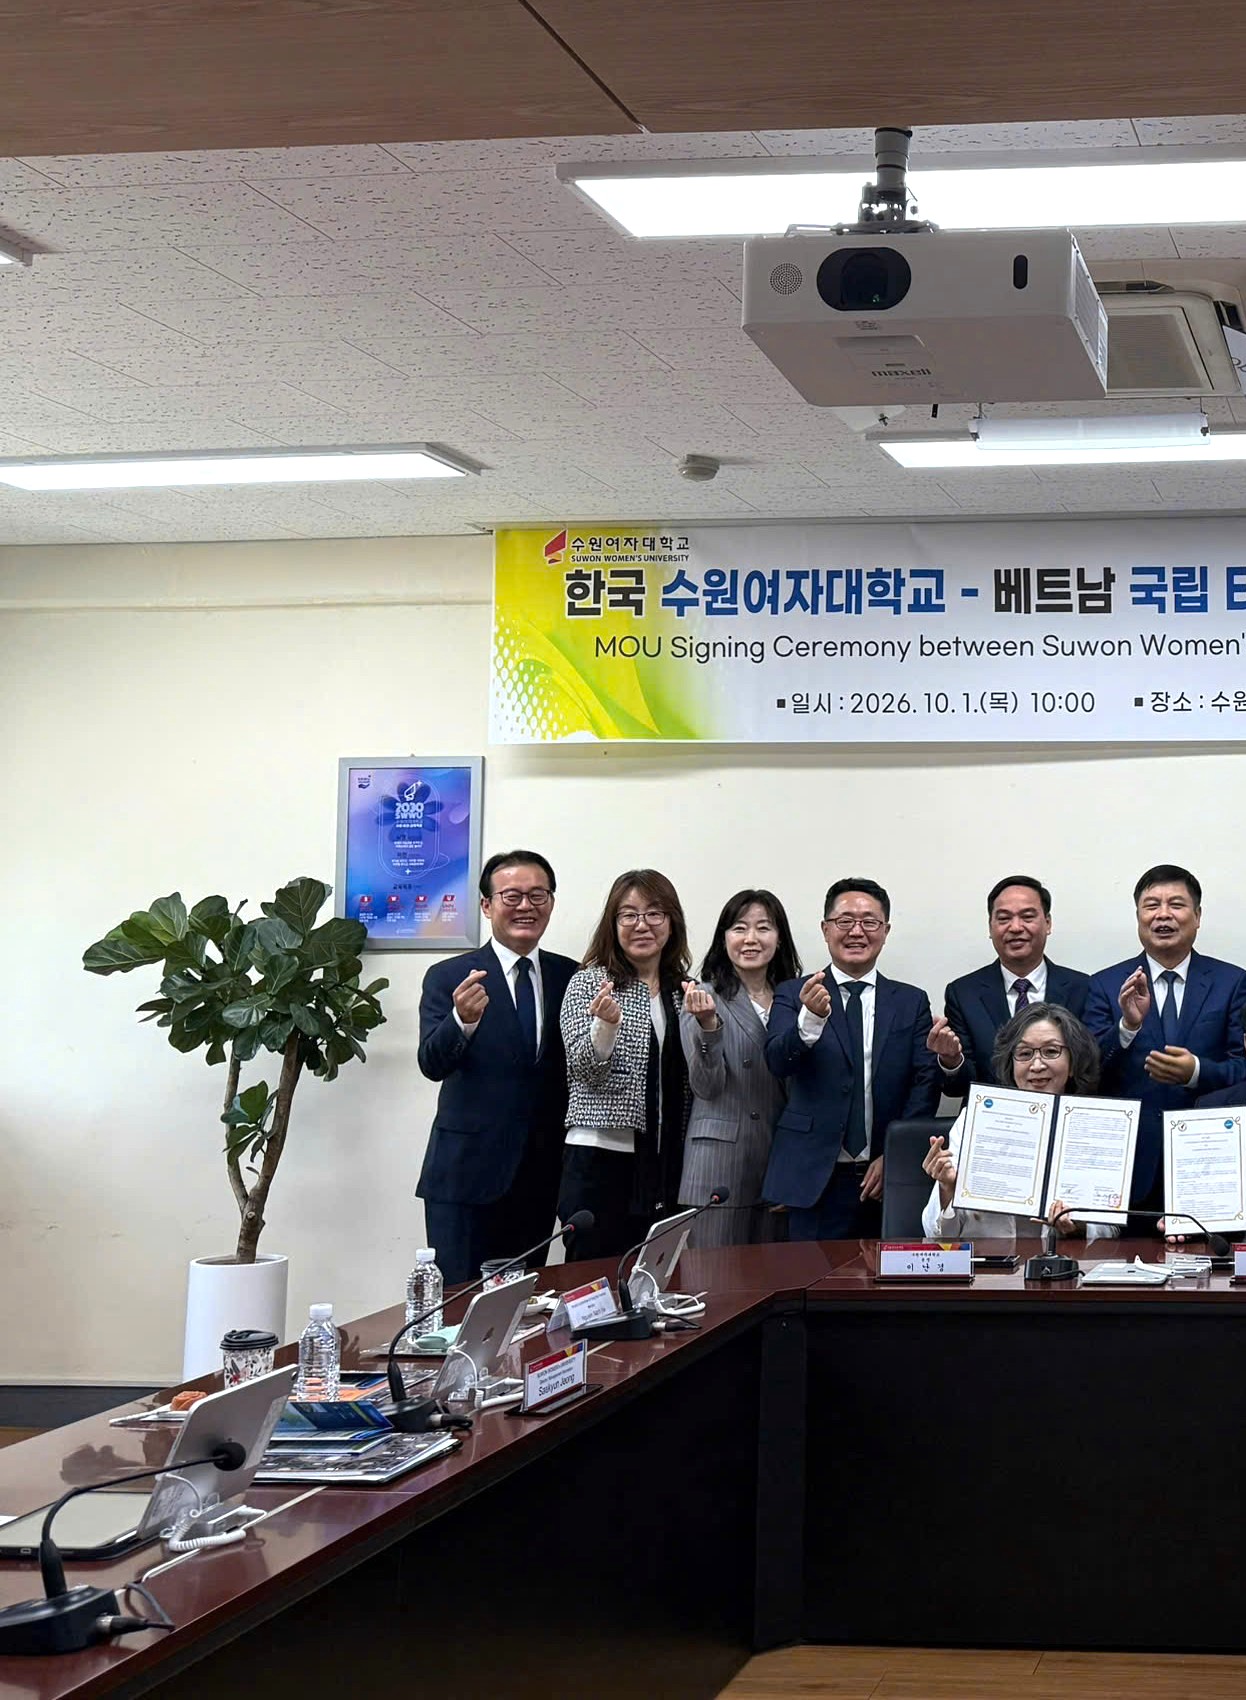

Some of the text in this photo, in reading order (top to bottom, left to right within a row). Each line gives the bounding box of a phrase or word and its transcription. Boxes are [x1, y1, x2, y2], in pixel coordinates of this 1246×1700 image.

[871, 368, 932, 377] maxell
[571, 536, 690, 552] 수원여자대학교
[571, 554, 690, 563] SUWON WOMEN'S UNIVERSITY
[565, 567, 646, 617] 한국
[660, 566, 946, 617] 수원여자대학교
[993, 567, 1116, 615] 베트남
[1129, 565, 1210, 616] 국립
[595, 635, 662, 658] MOU
[670, 635, 765, 664] Signing
[773, 635, 912, 664] Ceremony
[919, 634, 1034, 657] between
[1042, 634, 1132, 657] Suwon
[1031, 692, 1095, 713] 10:00
[395, 802, 424, 813] 2030
